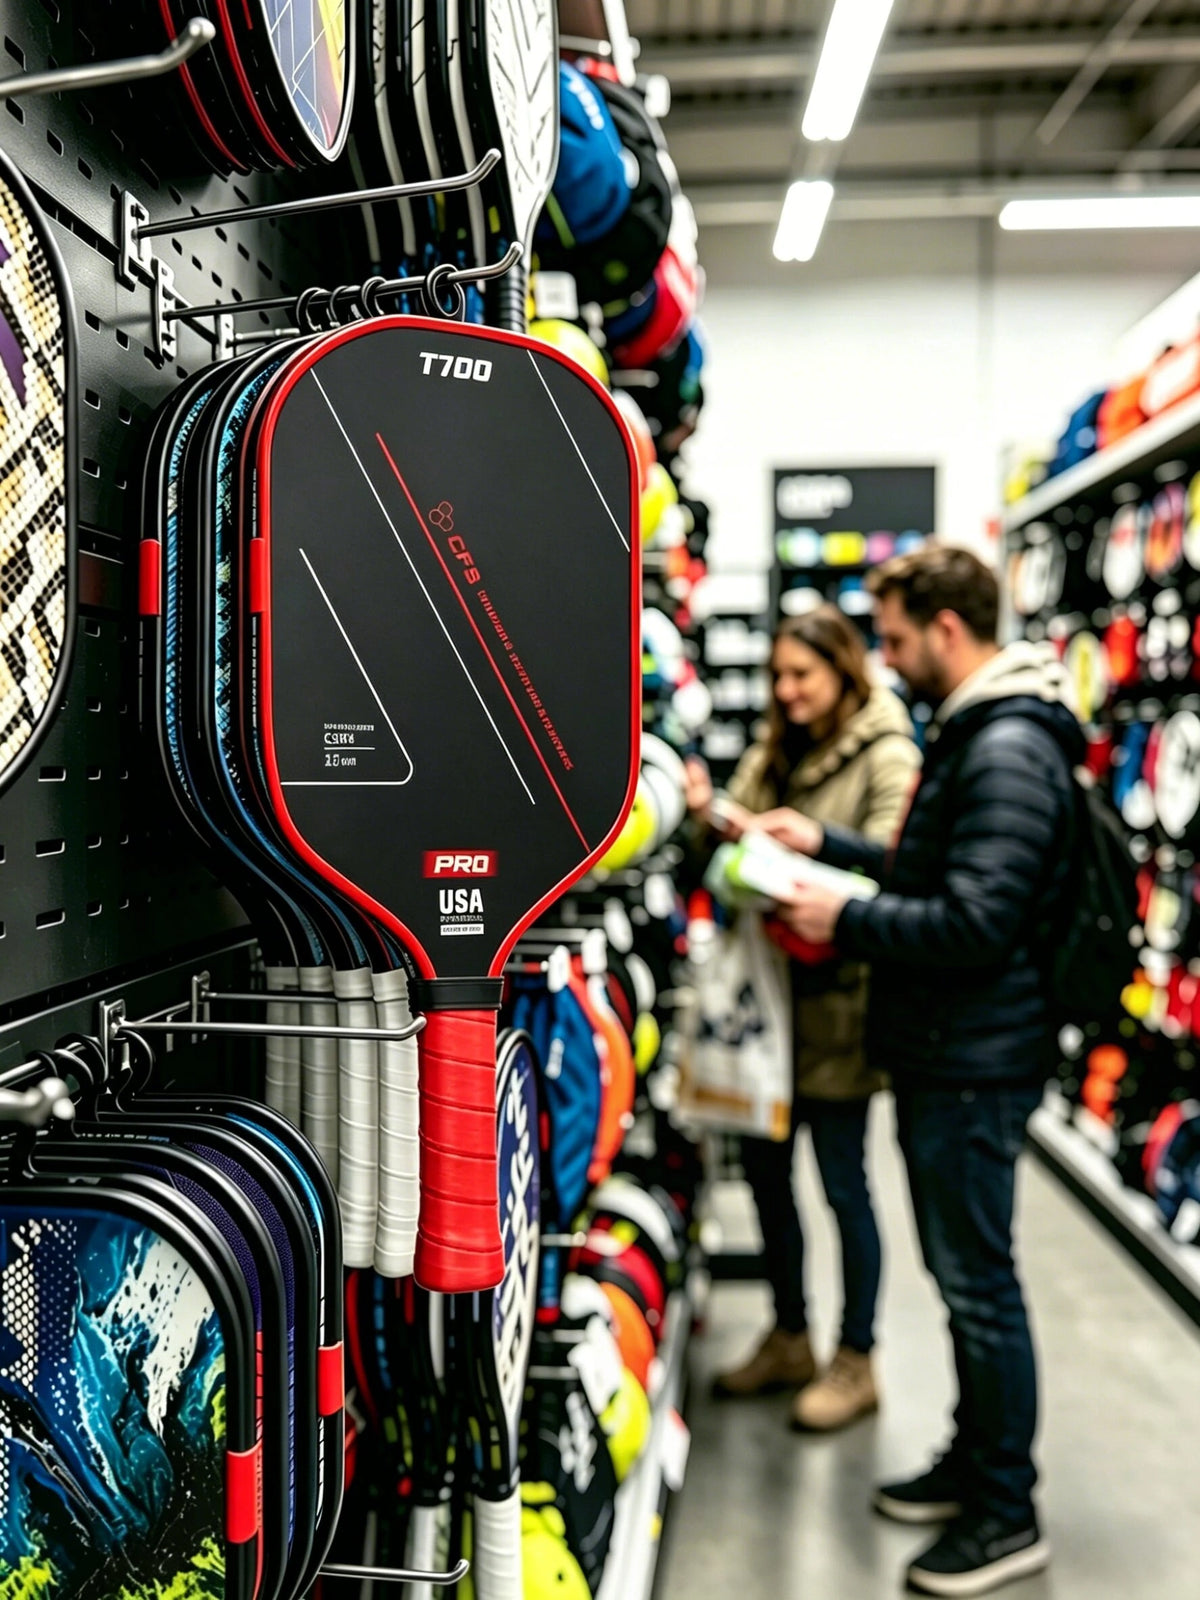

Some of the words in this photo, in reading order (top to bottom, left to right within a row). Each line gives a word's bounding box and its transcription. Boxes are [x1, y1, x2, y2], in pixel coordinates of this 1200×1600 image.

[419, 352, 493, 383] T700
[447, 535, 482, 585] CFS
[433, 855, 490, 874] PRO
[439, 888, 484, 914] USA
